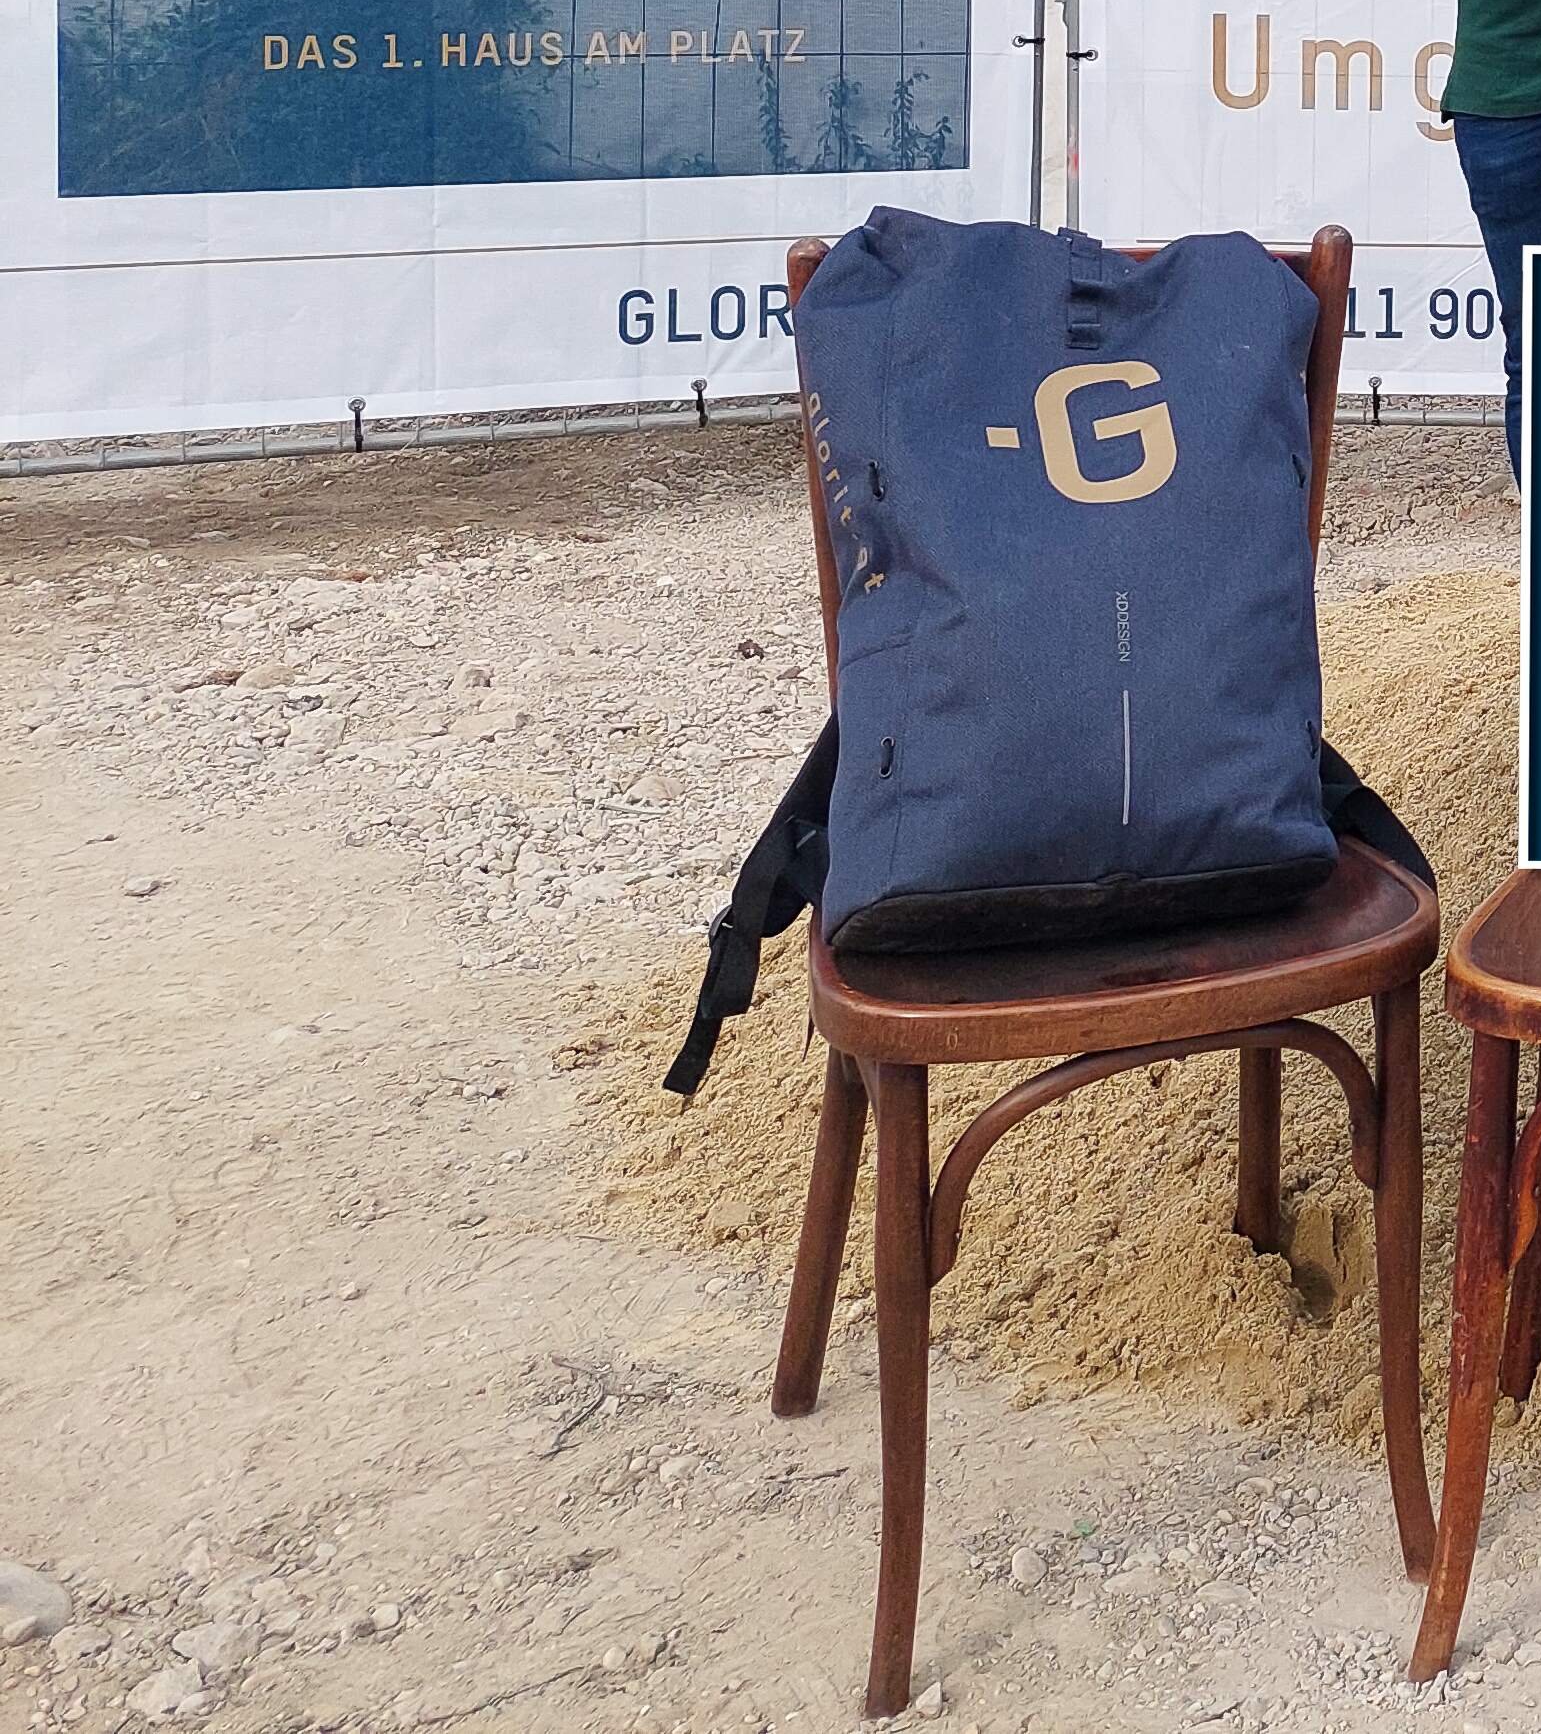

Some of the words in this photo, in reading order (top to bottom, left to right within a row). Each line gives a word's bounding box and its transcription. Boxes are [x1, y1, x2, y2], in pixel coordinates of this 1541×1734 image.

[262, 34, 358, 71] DAS
[382, 33, 423, 68] 1.
[441, 31, 565, 68] HAUS
[584, 30, 648, 66] AM
[669, 29, 808, 65] PLATZ
[618, 283, 795, 347] GLOR
